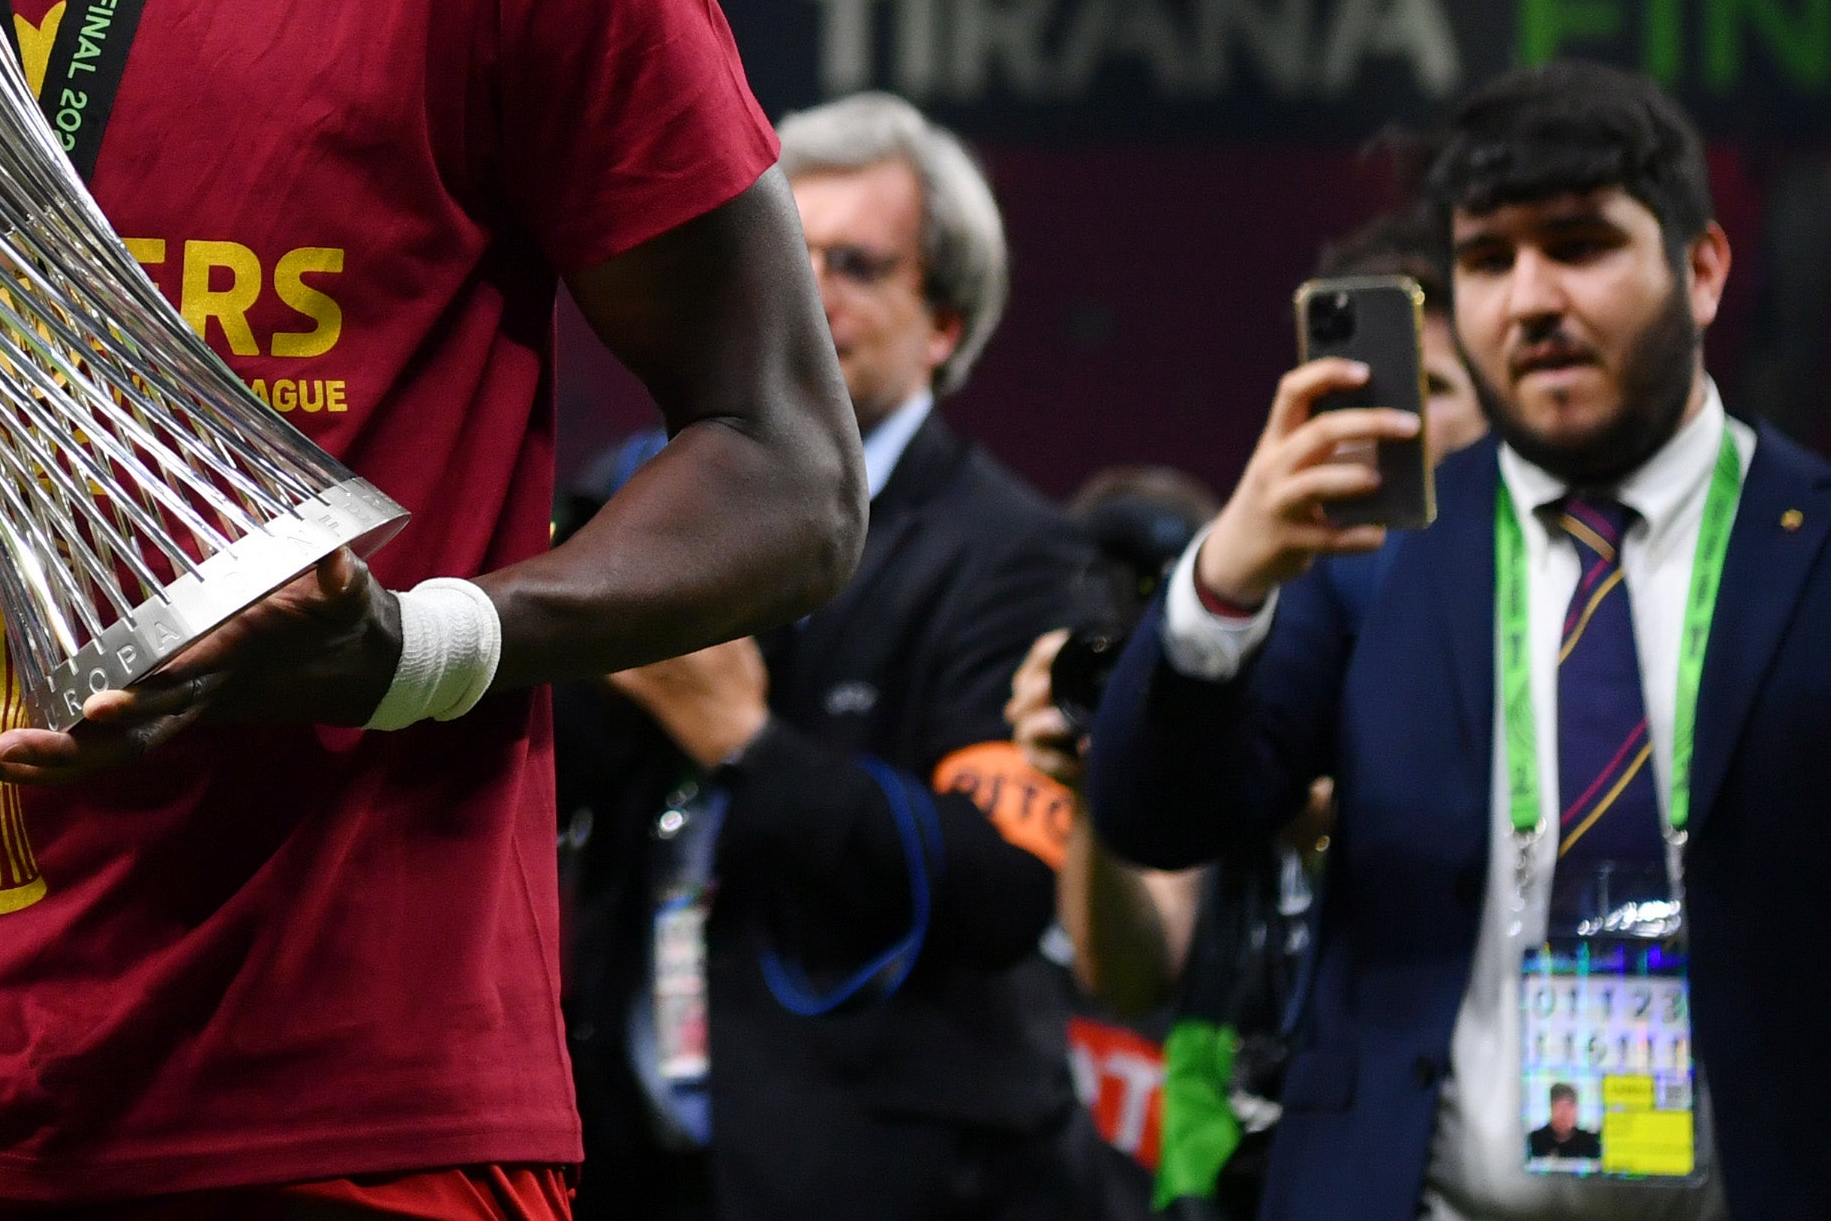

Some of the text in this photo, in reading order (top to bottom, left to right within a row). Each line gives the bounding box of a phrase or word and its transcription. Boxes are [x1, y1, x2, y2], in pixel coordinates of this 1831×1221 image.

[52, 88, 88, 152] 202
[251, 378, 348, 413] AGUE
[26, 618, 182, 732] UROPA
